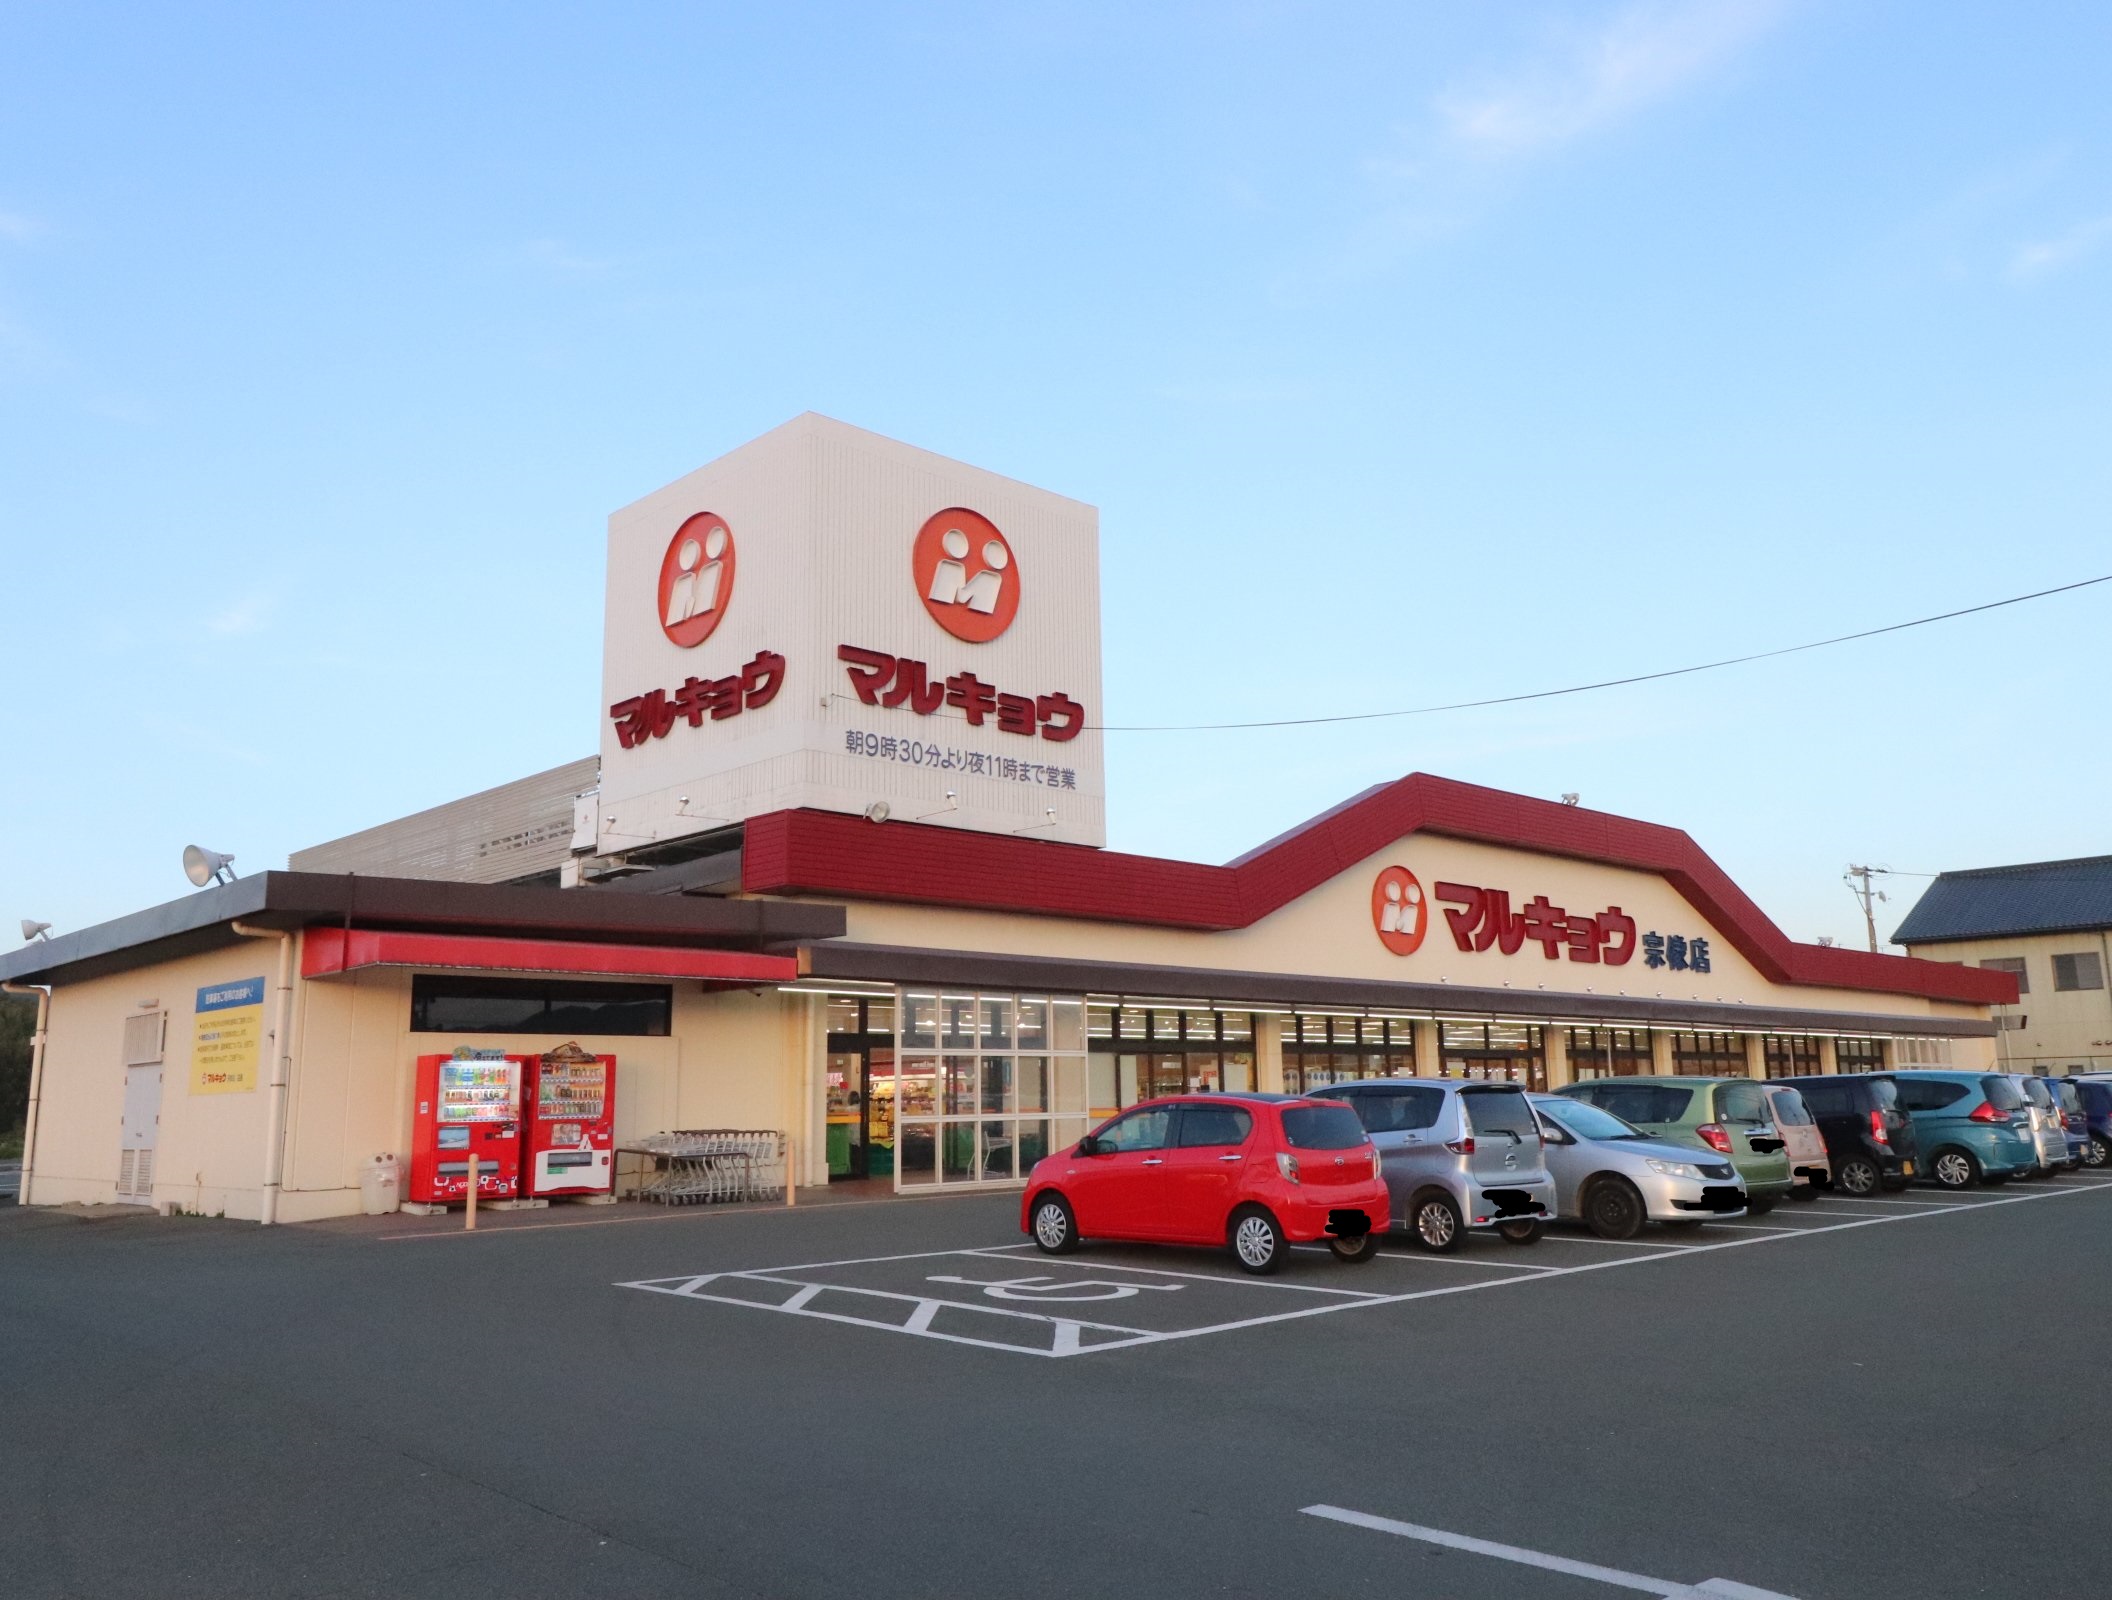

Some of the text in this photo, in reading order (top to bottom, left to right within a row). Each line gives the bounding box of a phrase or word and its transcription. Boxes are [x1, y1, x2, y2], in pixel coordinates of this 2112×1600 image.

[610, 650, 786, 749] マルキョウ
[838, 643, 1085, 742] マルキョウ
[845, 730, 1077, 790] 朝9時30分より夜11時まで営業
[1434, 881, 1636, 966] マルキョウ
